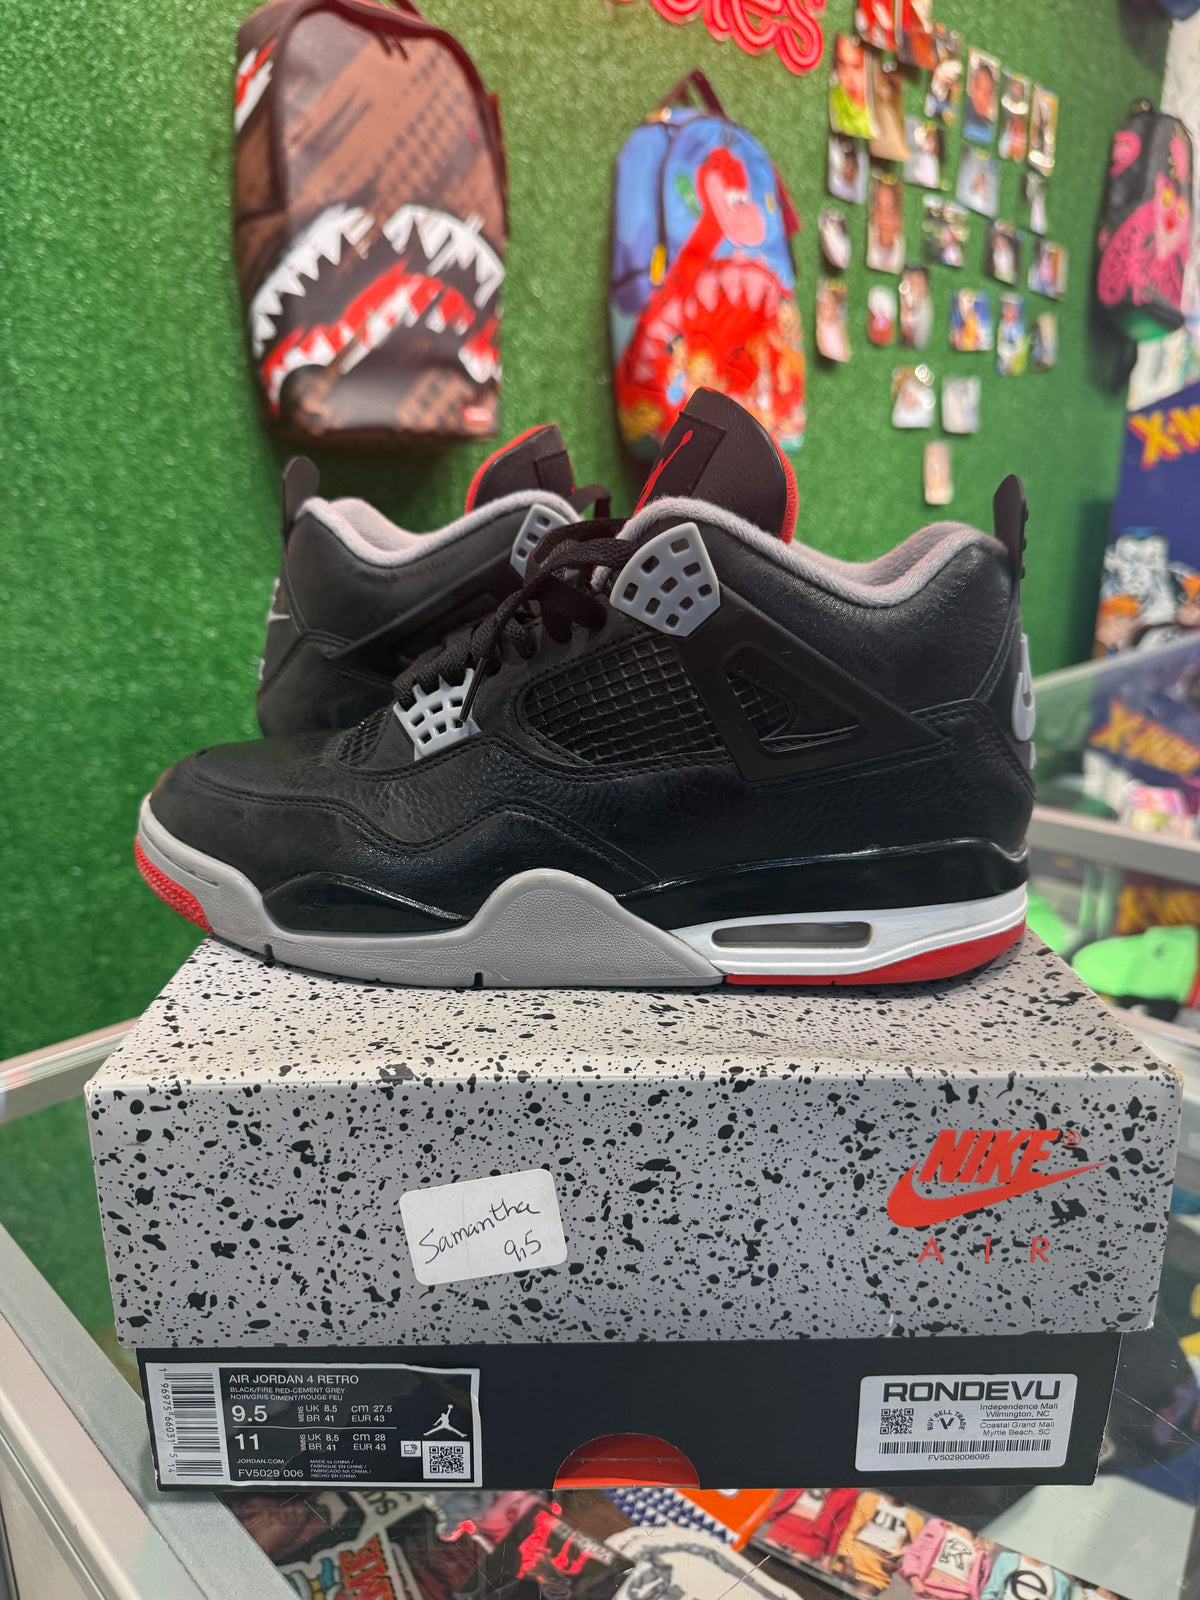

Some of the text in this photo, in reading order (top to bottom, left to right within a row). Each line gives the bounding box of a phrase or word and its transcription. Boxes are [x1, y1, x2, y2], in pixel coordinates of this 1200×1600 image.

[917, 1130, 1060, 1183] NIKE
[419, 1198, 541, 1264] Samantha
[917, 1236, 1049, 1264] AIR
[229, 1374, 359, 1384] AIR JORDAN 4 RETRO
[882, 1380, 1061, 1402] RONDEVU
[160, 1382, 172, 1411] 96975
[305, 1404, 338, 1413] UK 8.5
[350, 1404, 393, 1413] cm 27.5
[979, 1403, 1038, 1411] Independence
[231, 1405, 268, 1422] 9.5
[306, 1414, 320, 1422] BR
[351, 1414, 385, 1422] EUR 43
[926, 1409, 967, 1431] BUY SELL TRADE
[164, 1416, 176, 1443] 66031
[982, 1429, 1007, 1437] Myrtle
[1038, 1428, 1050, 1436] SC
[234, 1433, 260, 1450] 11
[307, 1433, 340, 1442] UK 8.5
[352, 1433, 386, 1442] cm 28
[353, 1443, 387, 1451] EUR 43
[927, 1453, 990, 1461] FV5029006095
[238, 1469, 304, 1477] FV5029 006
